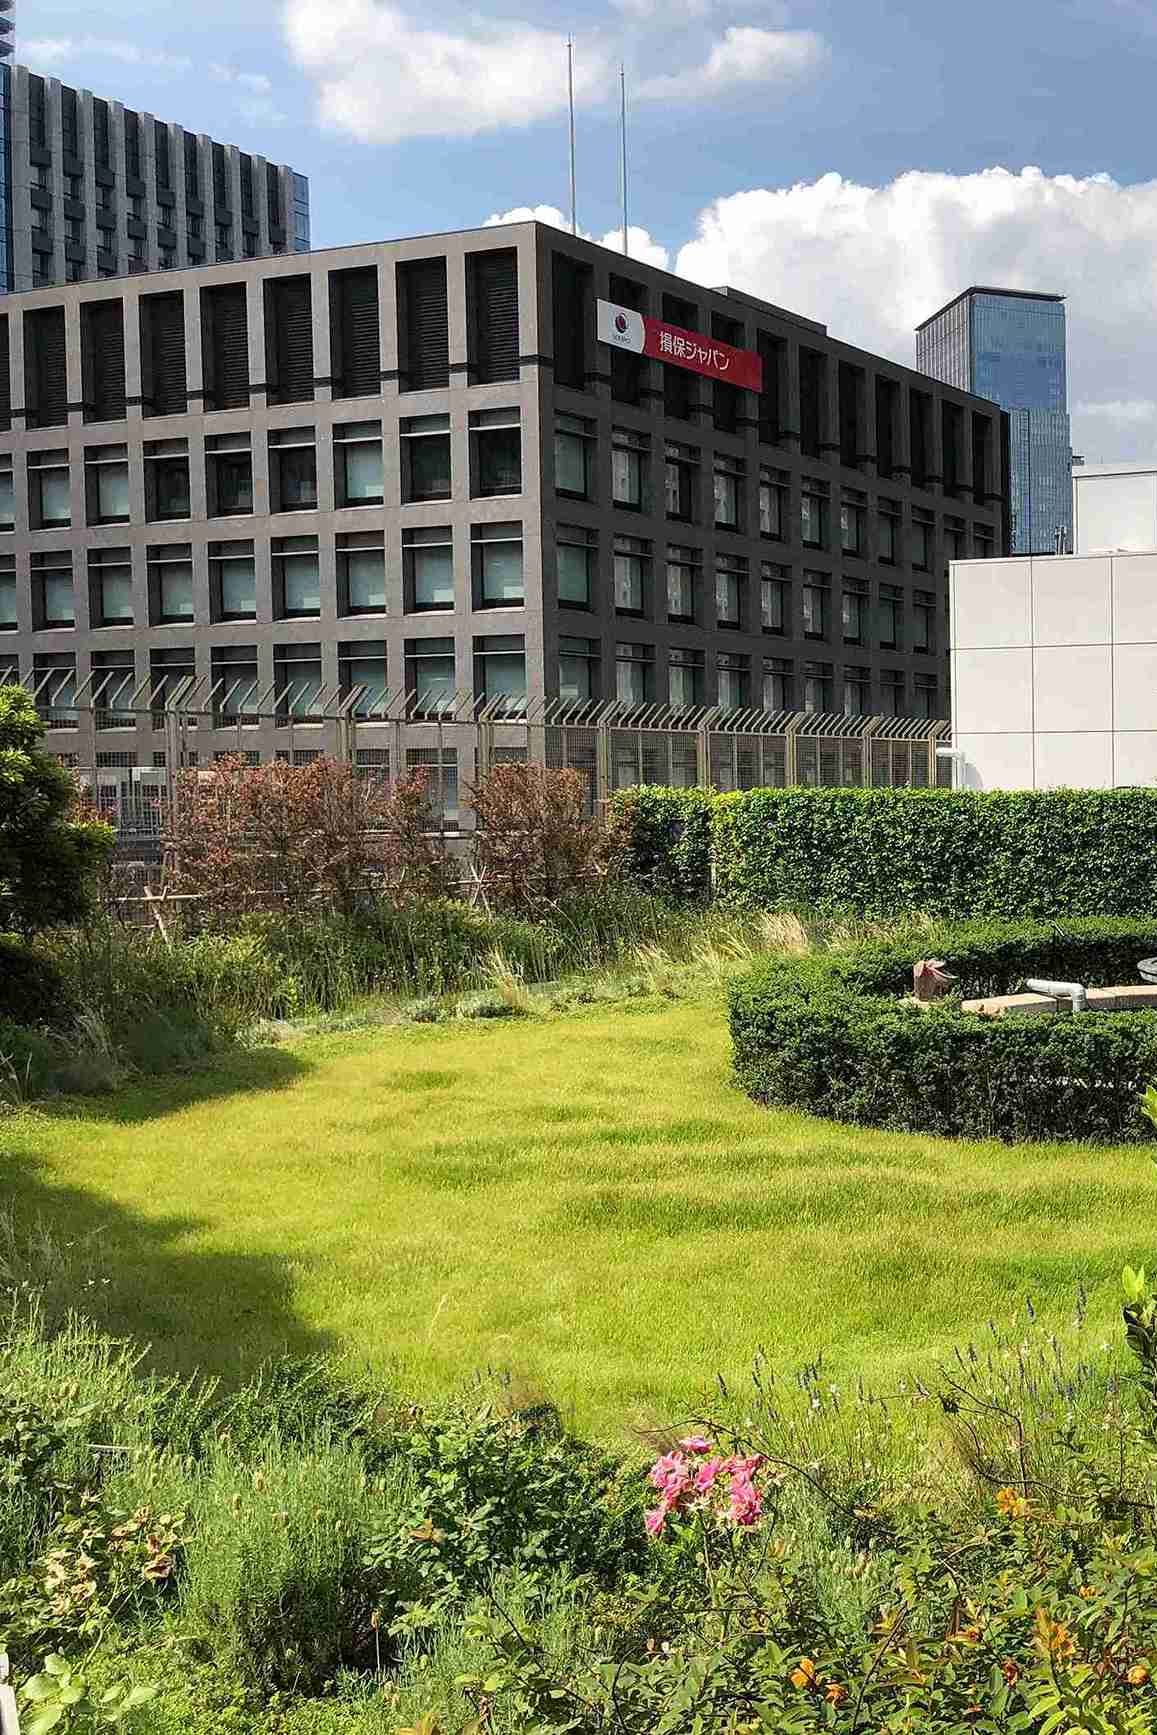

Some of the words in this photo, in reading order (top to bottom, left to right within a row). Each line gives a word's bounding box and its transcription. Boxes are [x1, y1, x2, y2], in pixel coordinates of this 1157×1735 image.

[660, 331, 730, 370] 損保ジャパン
